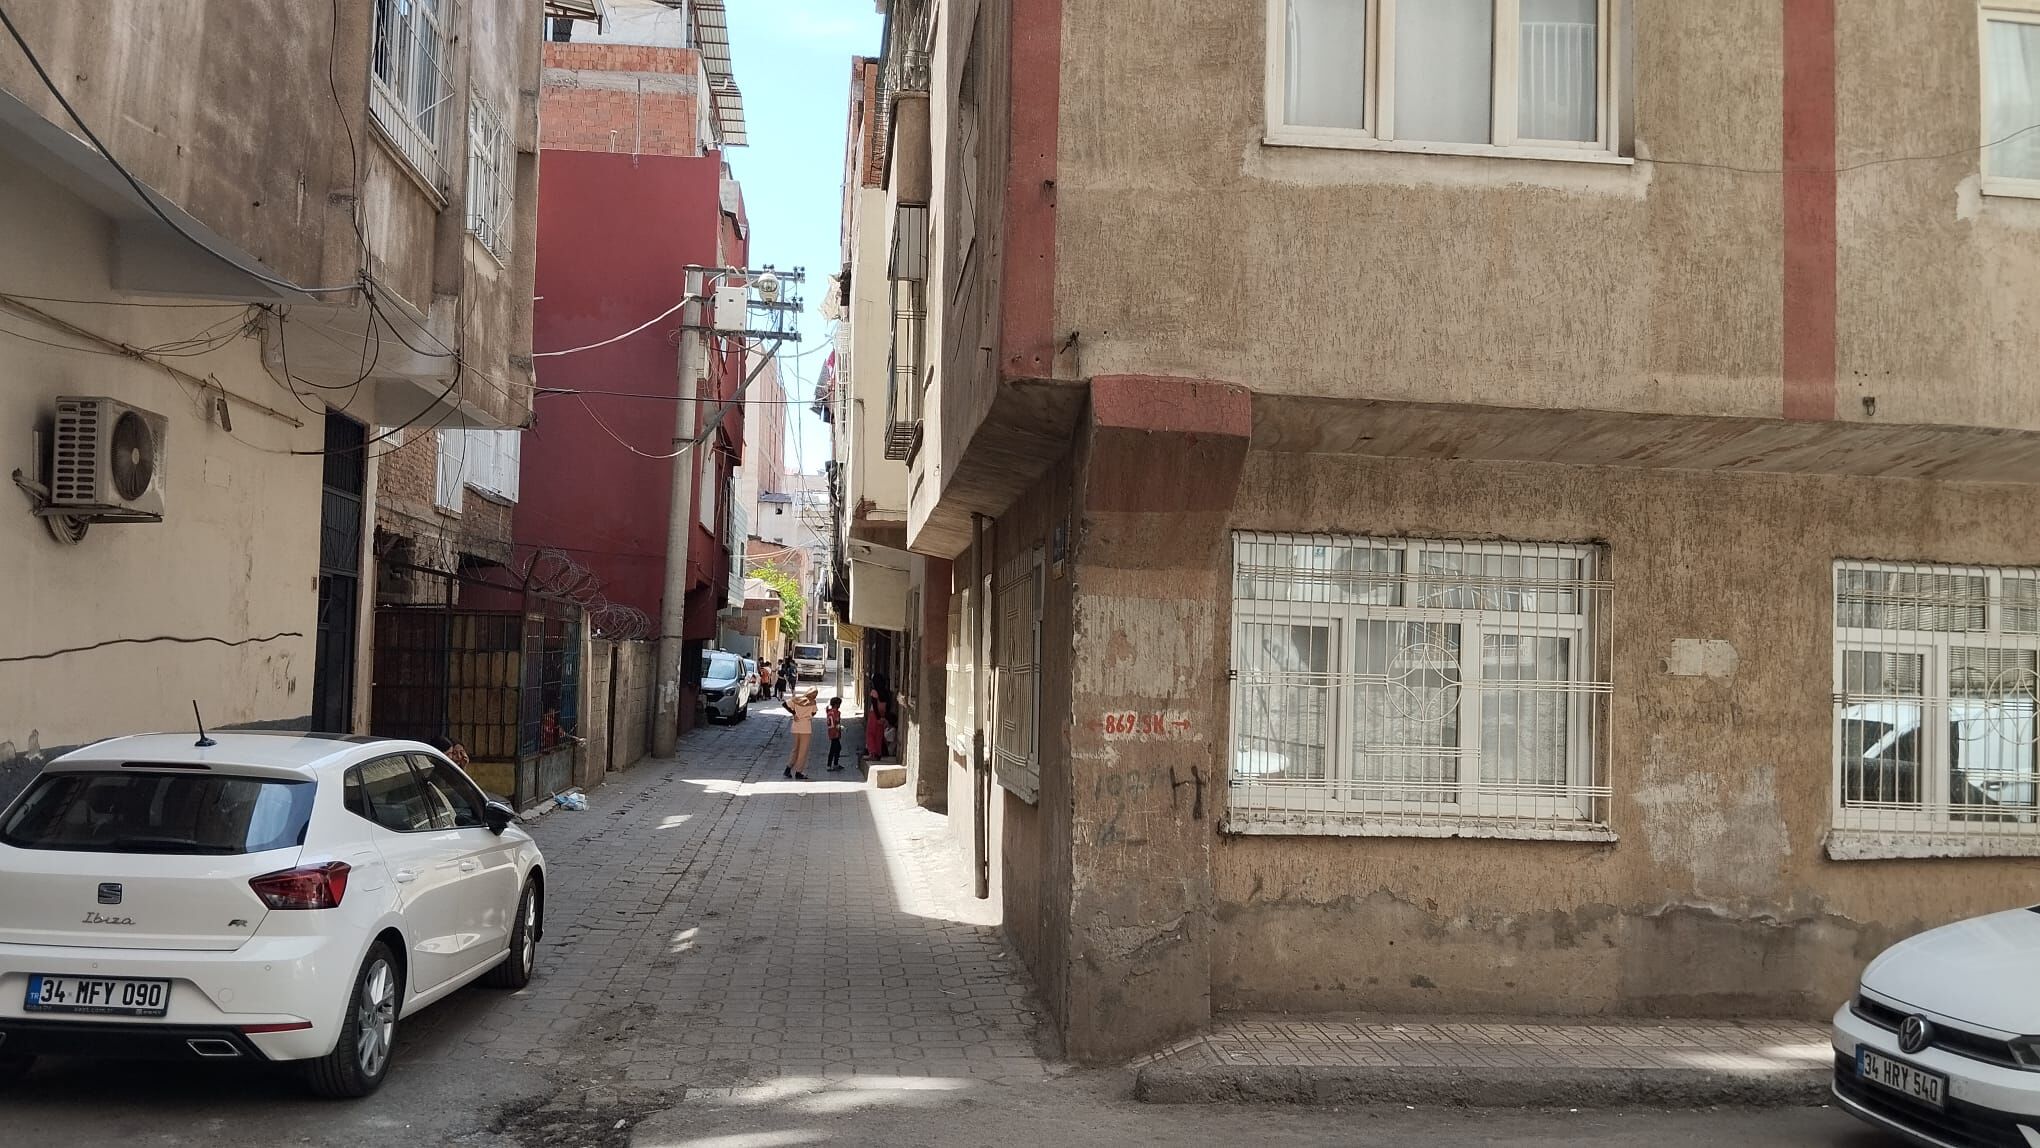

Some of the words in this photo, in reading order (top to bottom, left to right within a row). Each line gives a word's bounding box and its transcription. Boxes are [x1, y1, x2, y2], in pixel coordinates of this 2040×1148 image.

[82, 912, 136, 926] Ibiza
[41, 979, 66, 1003] 34
[75, 981, 116, 1005] MFY
[122, 983, 162, 1007] 090
[1865, 1054, 1878, 1079] 34
[1884, 1060, 1908, 1090] HRY
[1914, 1072, 1938, 1101] 540
